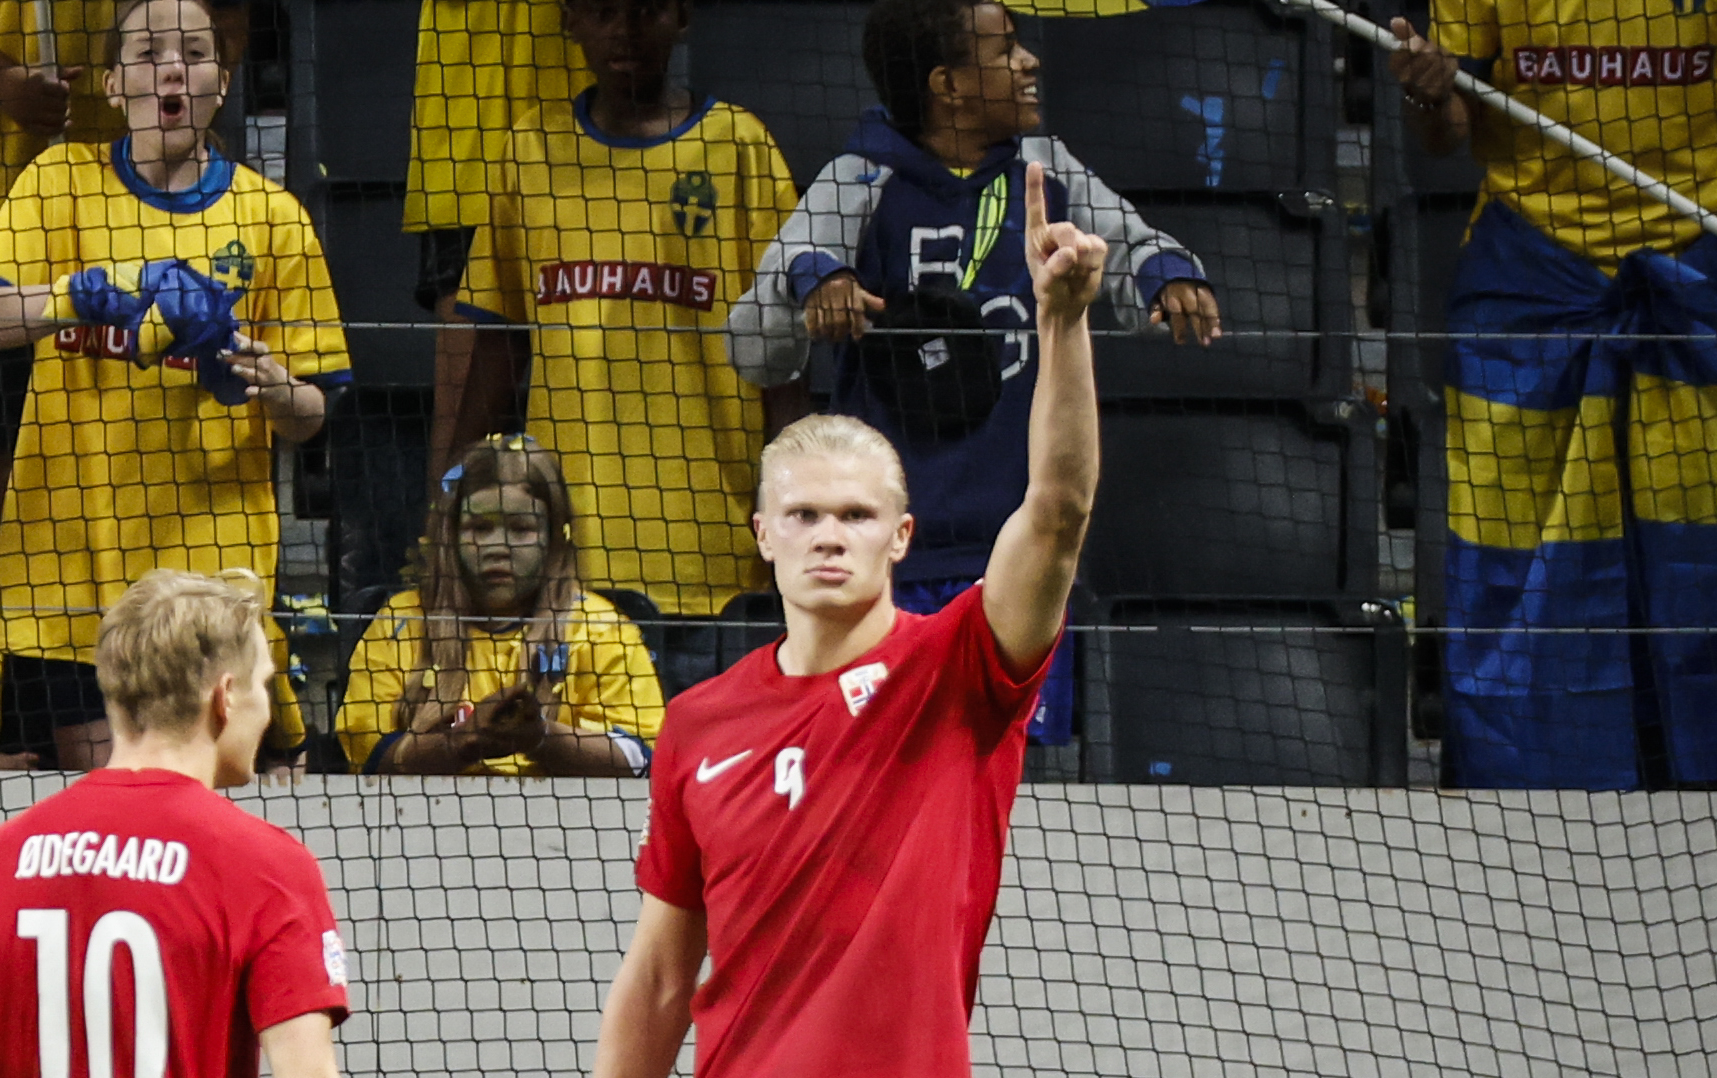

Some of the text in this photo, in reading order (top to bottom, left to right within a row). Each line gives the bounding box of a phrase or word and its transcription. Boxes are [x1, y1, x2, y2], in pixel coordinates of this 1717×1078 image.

[1518, 51, 1710, 80] BAUHAUS
[774, 746, 805, 811] 9
[14, 831, 189, 885] ØDEGAARD
